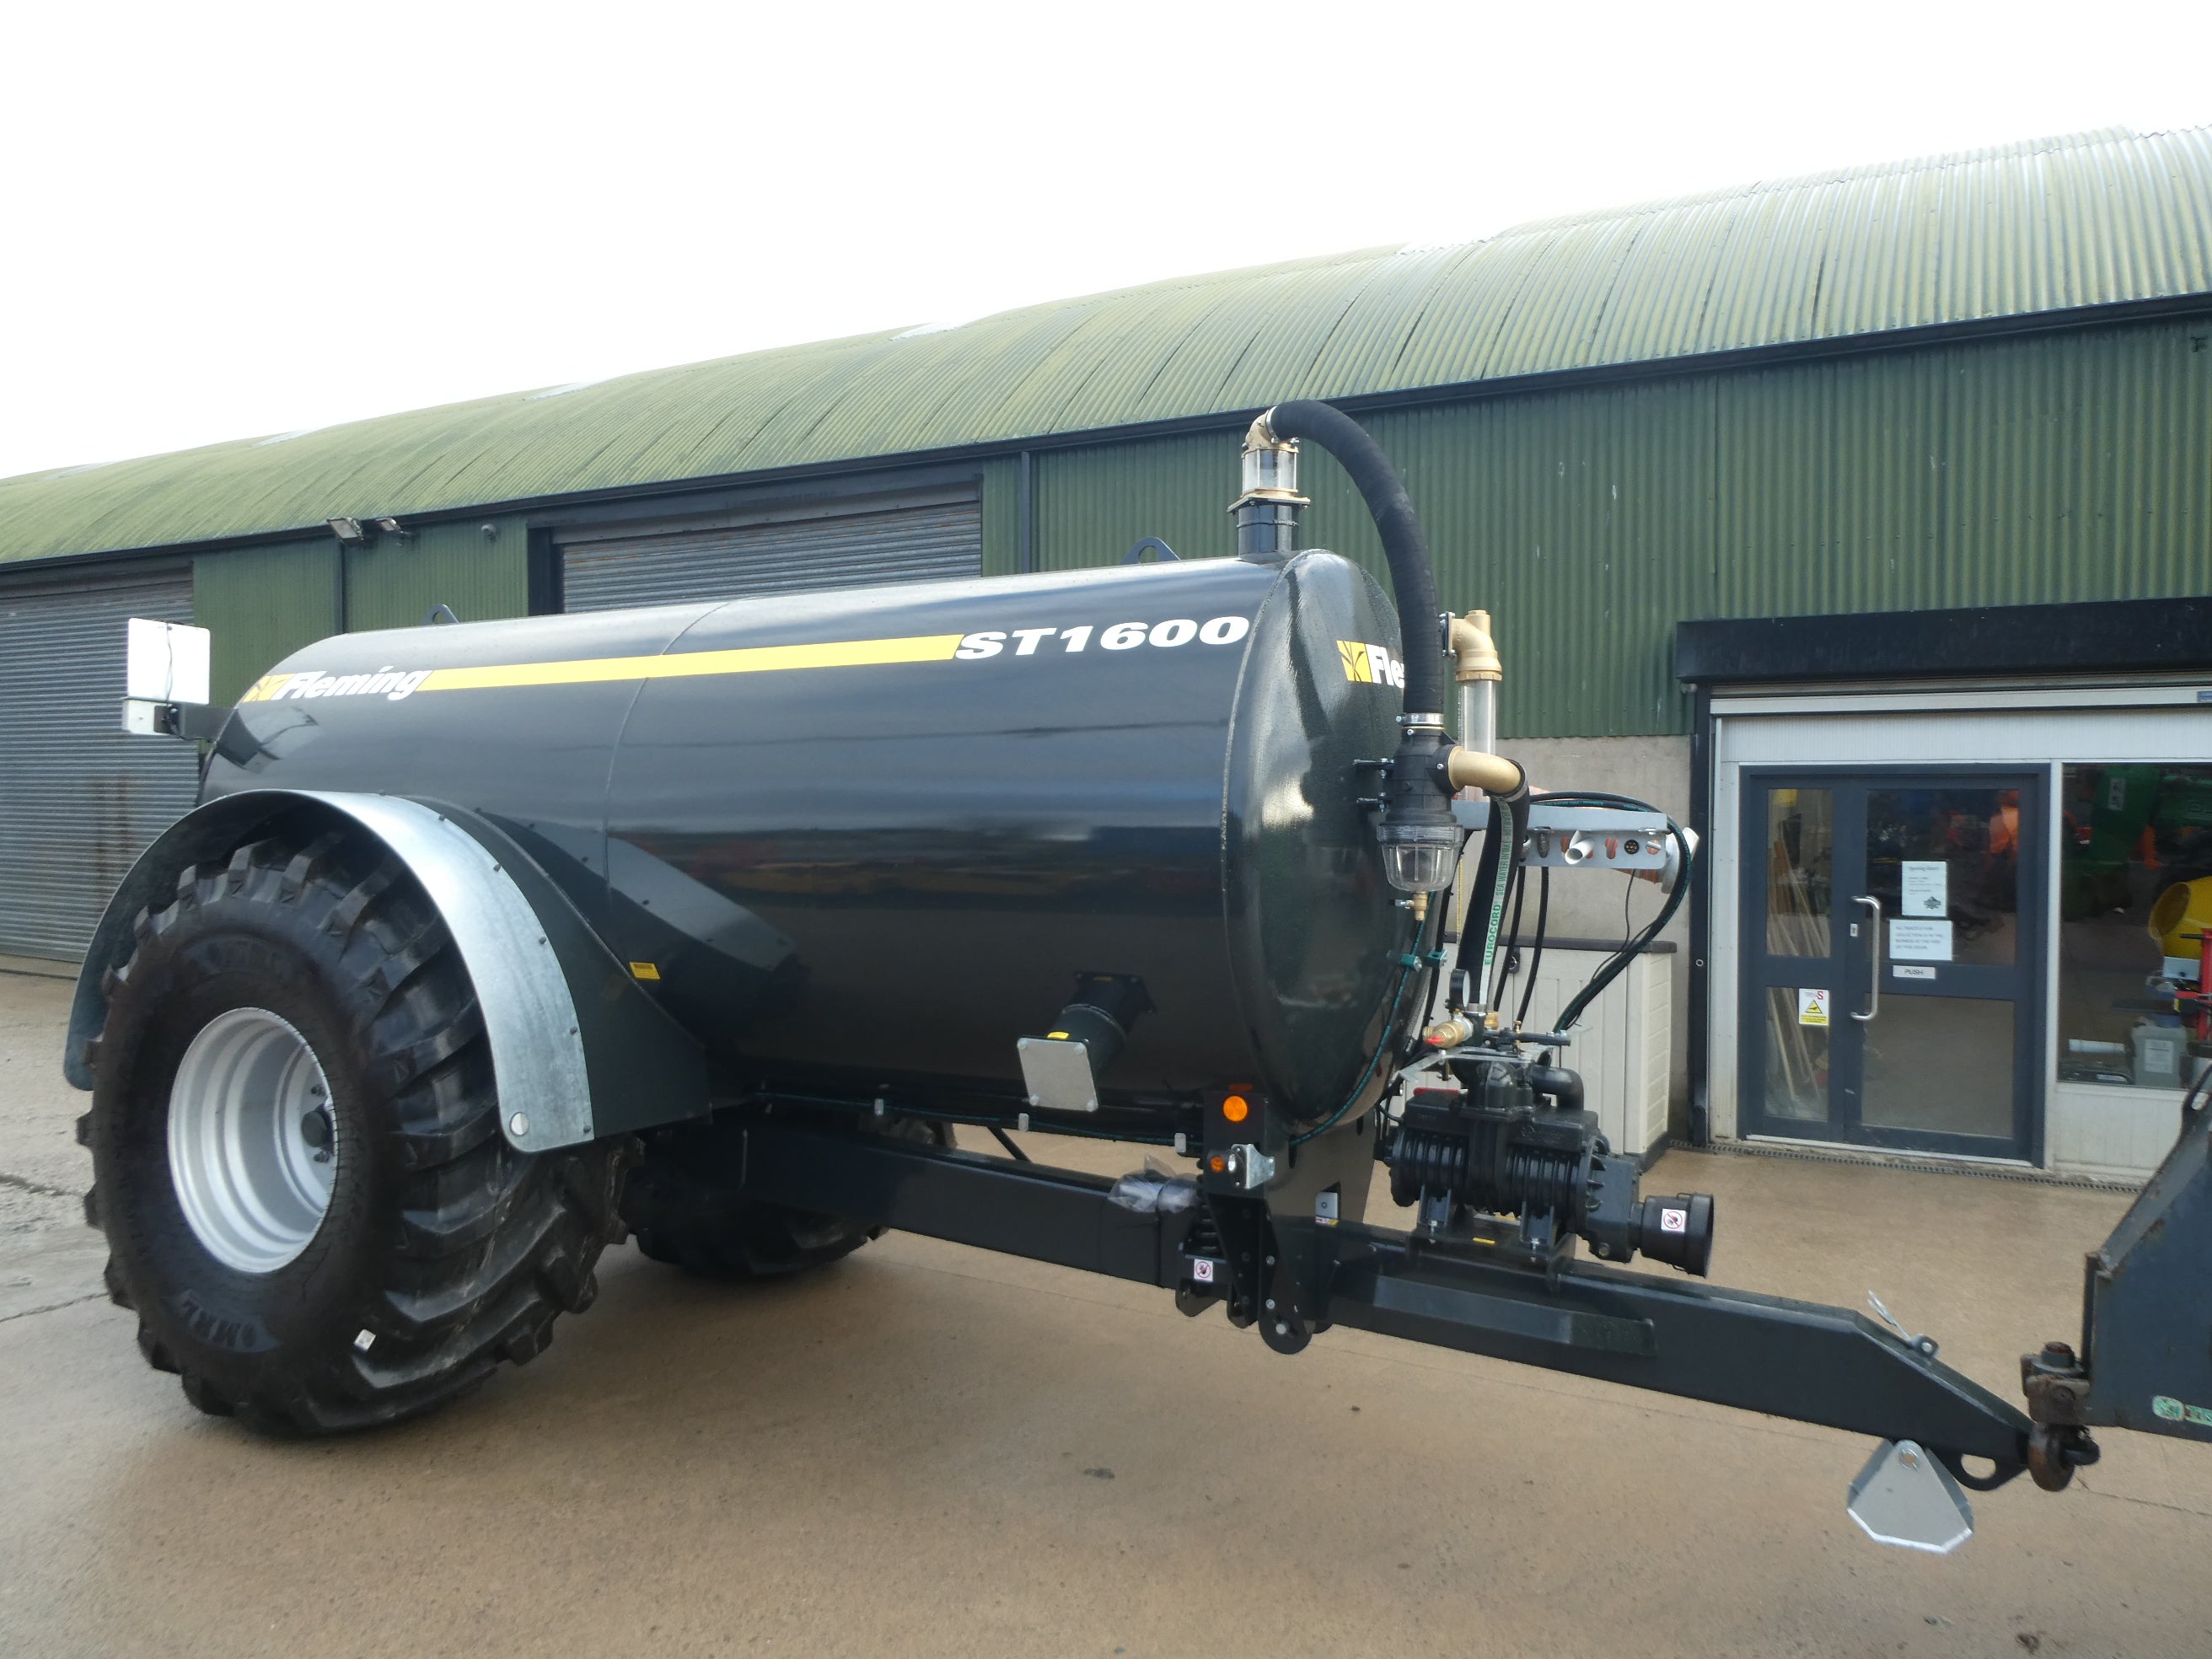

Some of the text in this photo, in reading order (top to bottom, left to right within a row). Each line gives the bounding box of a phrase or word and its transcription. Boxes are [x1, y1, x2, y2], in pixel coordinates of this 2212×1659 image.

[955, 616, 1249, 660] ST1600
[270, 665, 433, 701] Fleming
[1366, 643, 1405, 689] Fle
[1497, 861, 1510, 881] WATER
[1495, 883, 1506, 896] SEA
